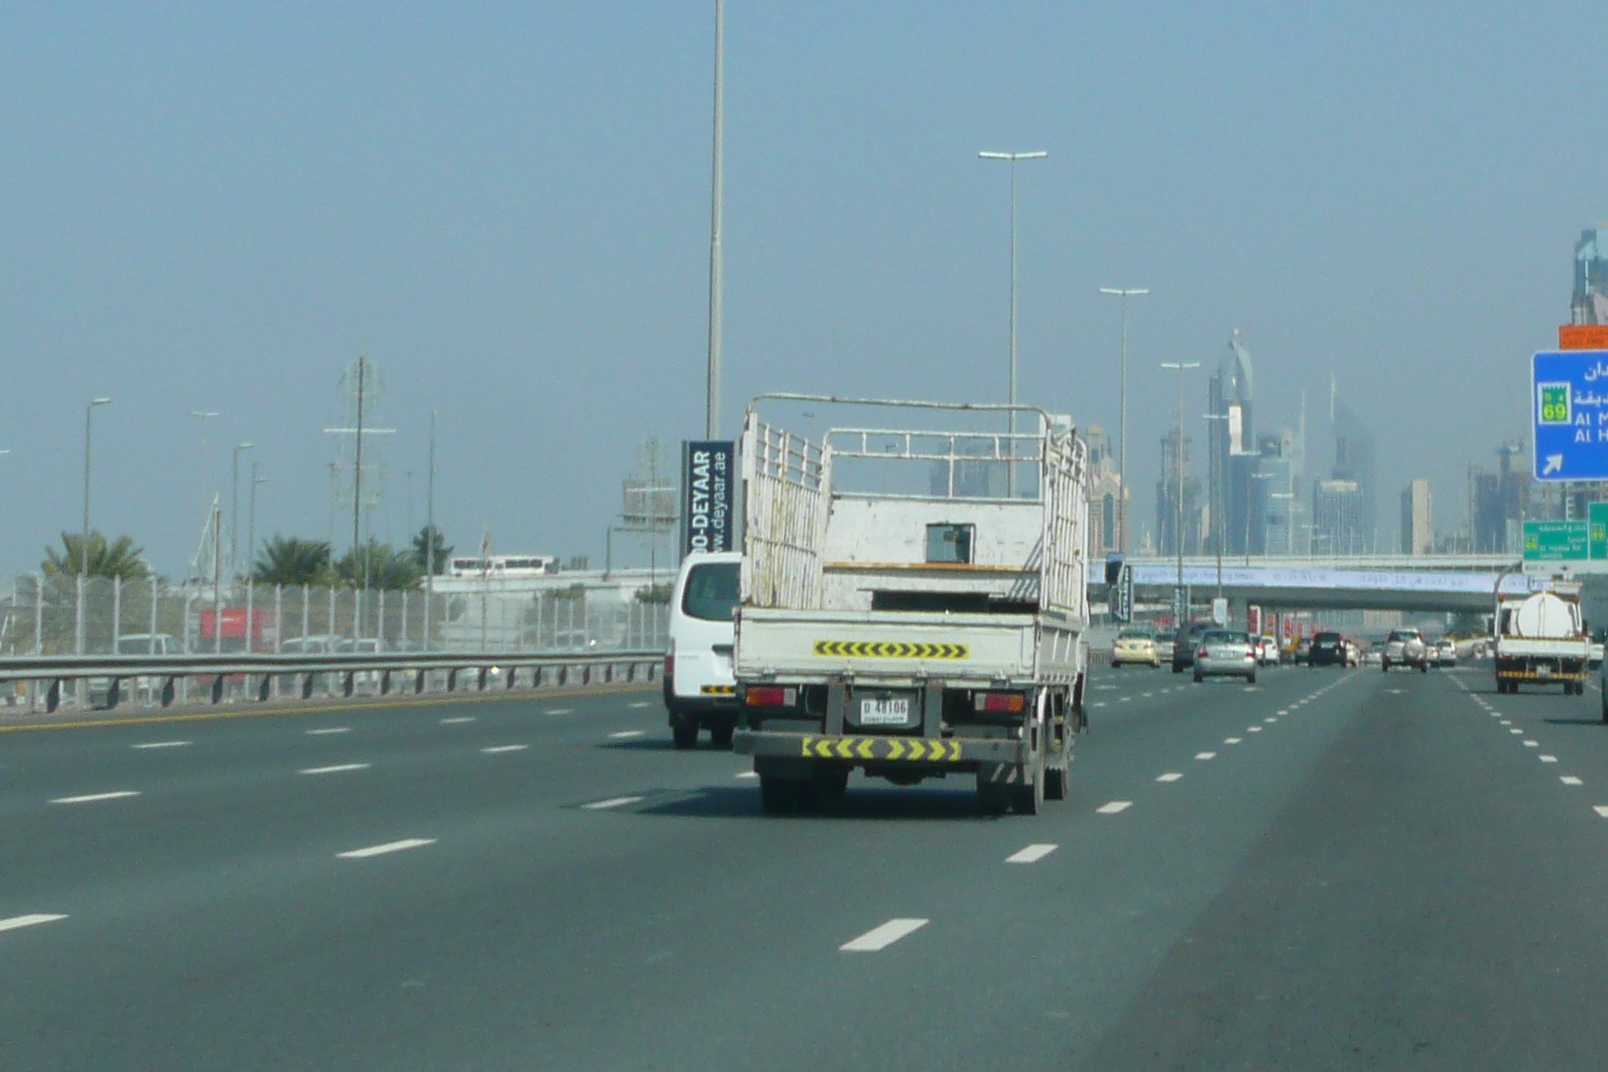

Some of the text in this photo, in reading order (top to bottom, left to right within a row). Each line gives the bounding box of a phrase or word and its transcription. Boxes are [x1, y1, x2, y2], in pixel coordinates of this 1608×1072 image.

[1544, 403, 1566, 420] 69
[1575, 412, 1591, 426] Al
[1575, 428, 1591, 442] Al
